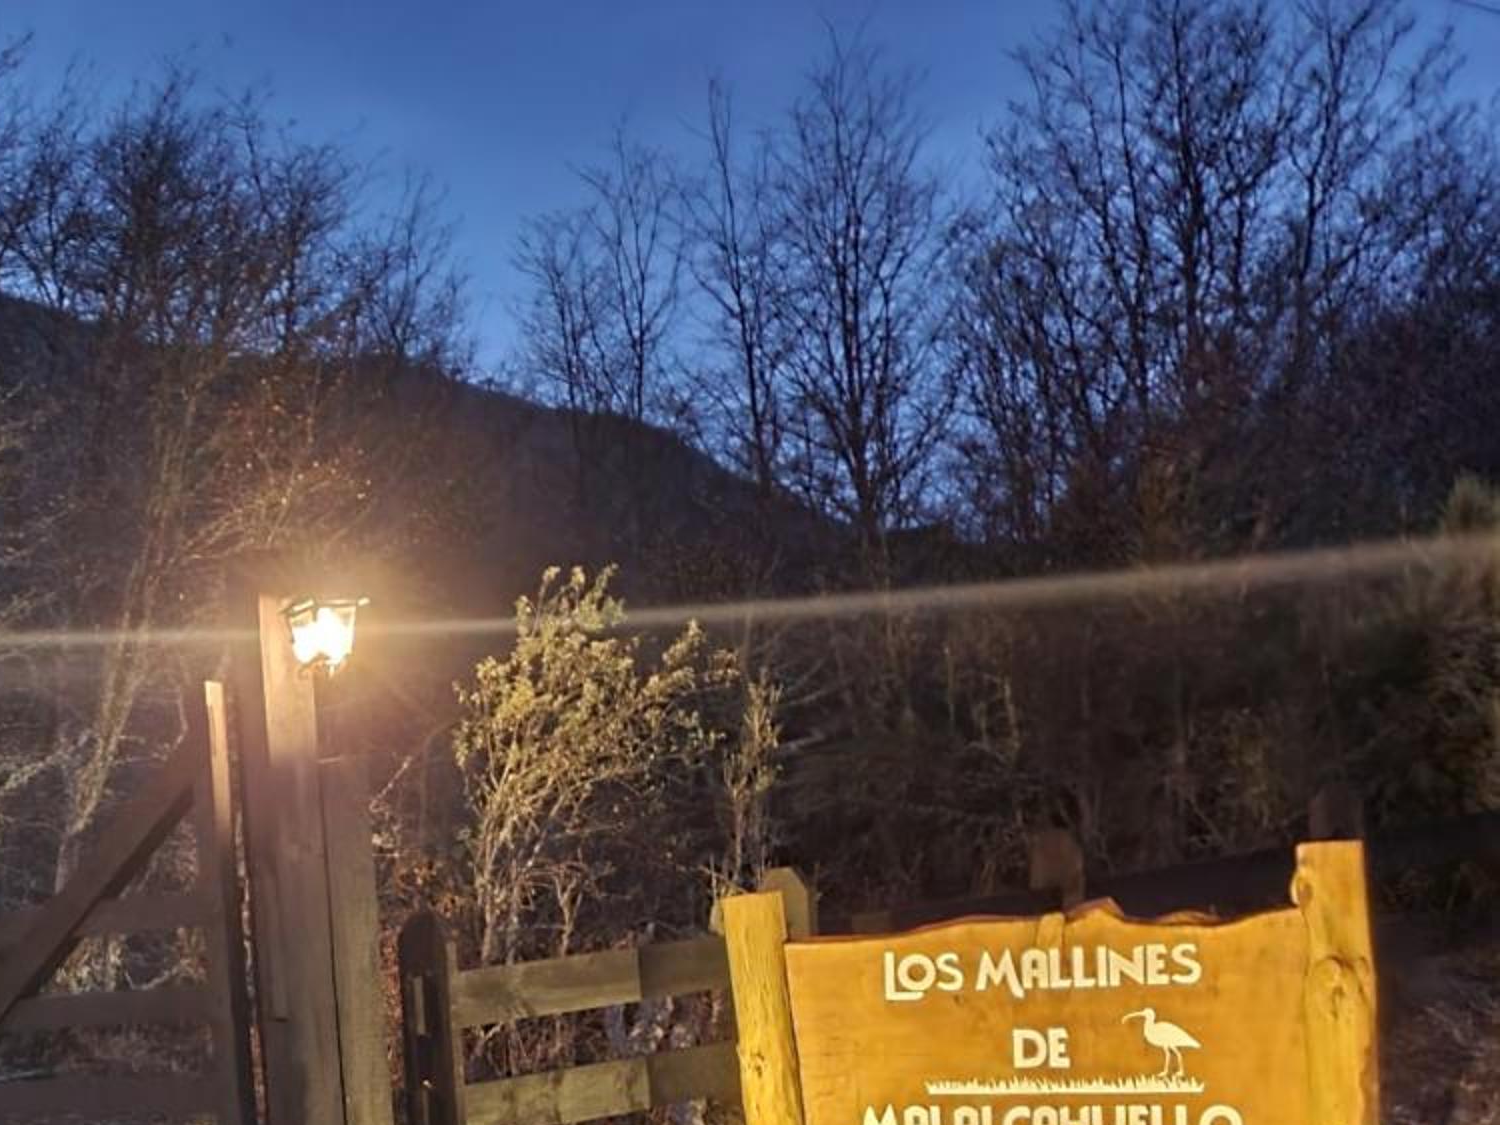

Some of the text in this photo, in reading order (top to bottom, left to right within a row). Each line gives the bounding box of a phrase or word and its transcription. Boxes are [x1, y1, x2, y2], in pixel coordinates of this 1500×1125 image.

[883, 943, 1202, 1001] LOS MALLINES
[1011, 1027, 1071, 1069] DE
